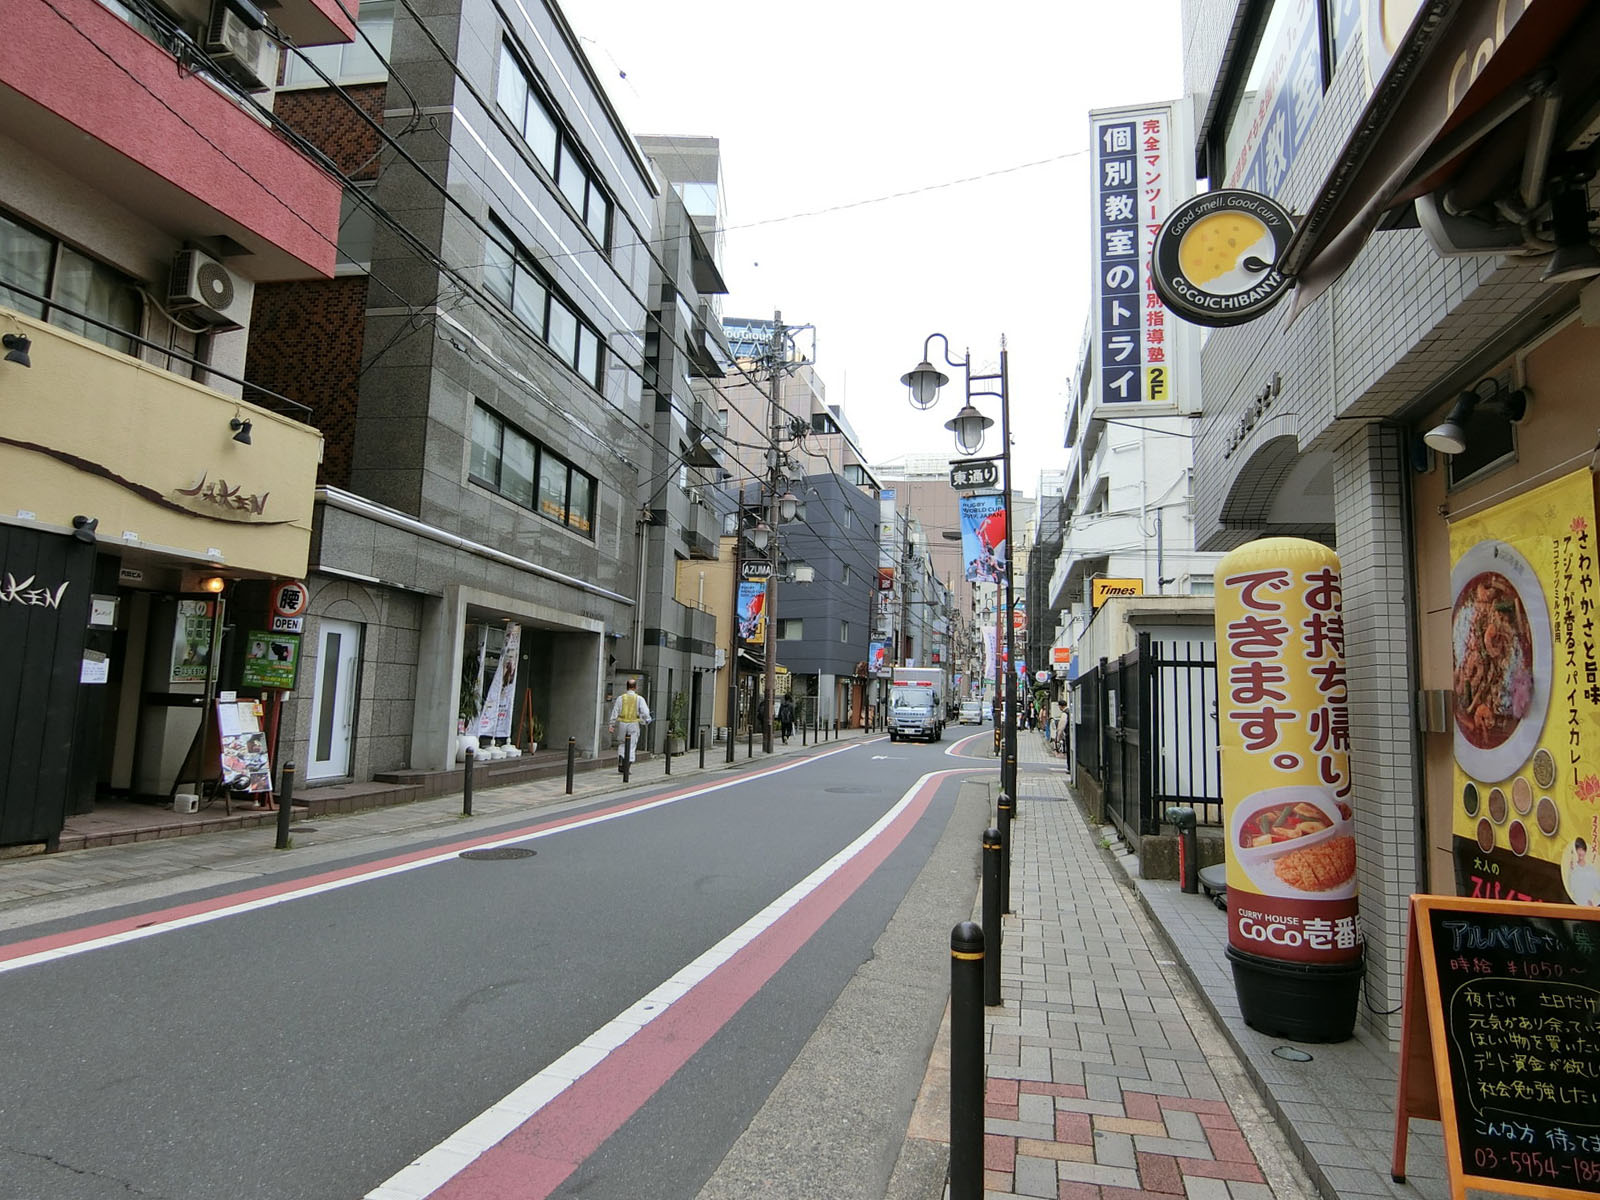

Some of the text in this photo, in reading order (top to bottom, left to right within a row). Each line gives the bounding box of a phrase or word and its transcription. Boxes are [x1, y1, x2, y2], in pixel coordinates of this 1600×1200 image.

[1171, 196, 1281, 236] Good smell. Good curry
[1143, 119, 1165, 363] 完全マンツーマ別指導塾
[1103, 127, 1135, 398] 個別教室のトライ
[1150, 368, 1164, 400] 2F
[952, 466, 997, 486] 東通り
[744, 564, 772, 575] AZUMA
[279, 588, 301, 610] 腰
[1099, 584, 1137, 596] Times
[275, 618, 299, 630] OPEN
[1577, 530, 1600, 705] さわやかさと旨味
[1225, 570, 1300, 770] できます。
[1563, 535, 1581, 786] アジアが香るスパイスカレー
[1303, 567, 1352, 798] お持ち帰り
[1473, 856, 1500, 876] 大人の
[1238, 907, 1299, 926] CURRY HOUSE
[1450, 955, 1493, 974] 時給
[1464, 987, 1597, 1014] 夜だけ 土日だけ
[1474, 1118, 1535, 1144] こんな方
